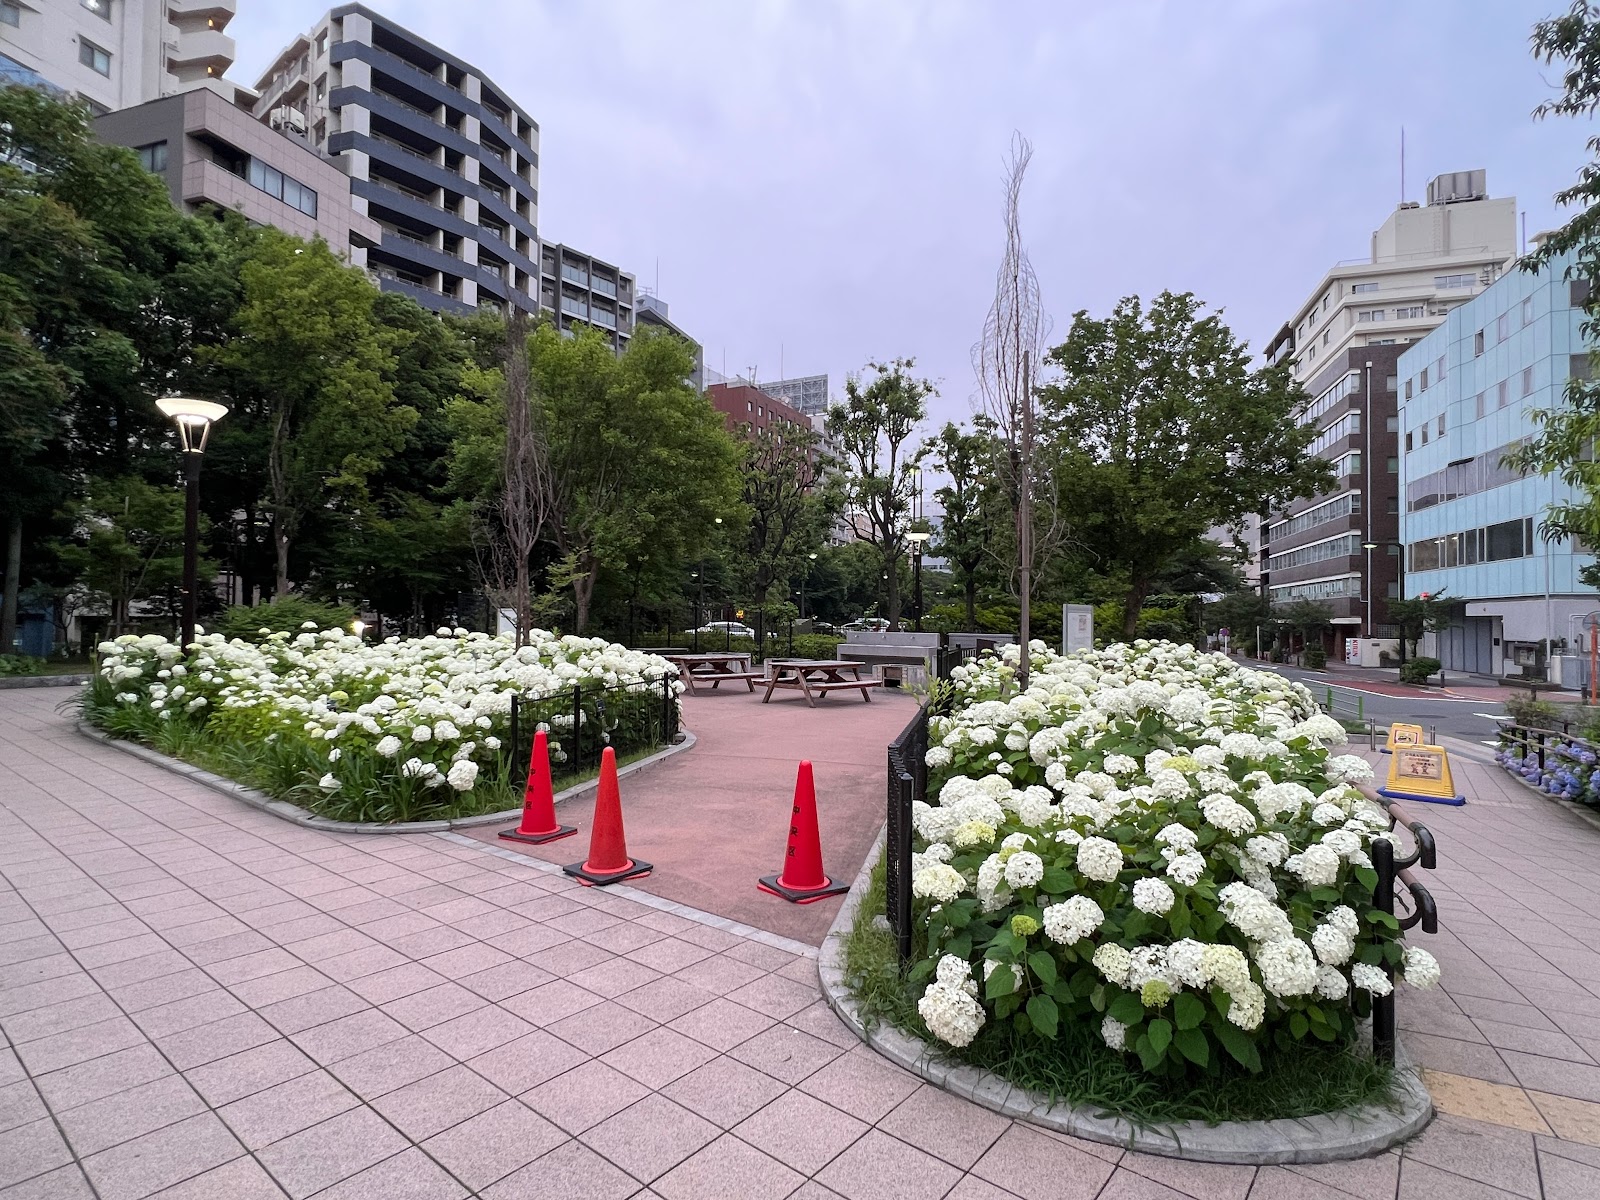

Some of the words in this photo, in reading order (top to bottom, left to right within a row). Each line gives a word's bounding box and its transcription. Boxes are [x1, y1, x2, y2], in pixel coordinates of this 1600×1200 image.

[526, 768, 536, 809] 中央区
[788, 806, 800, 856] 中央区
